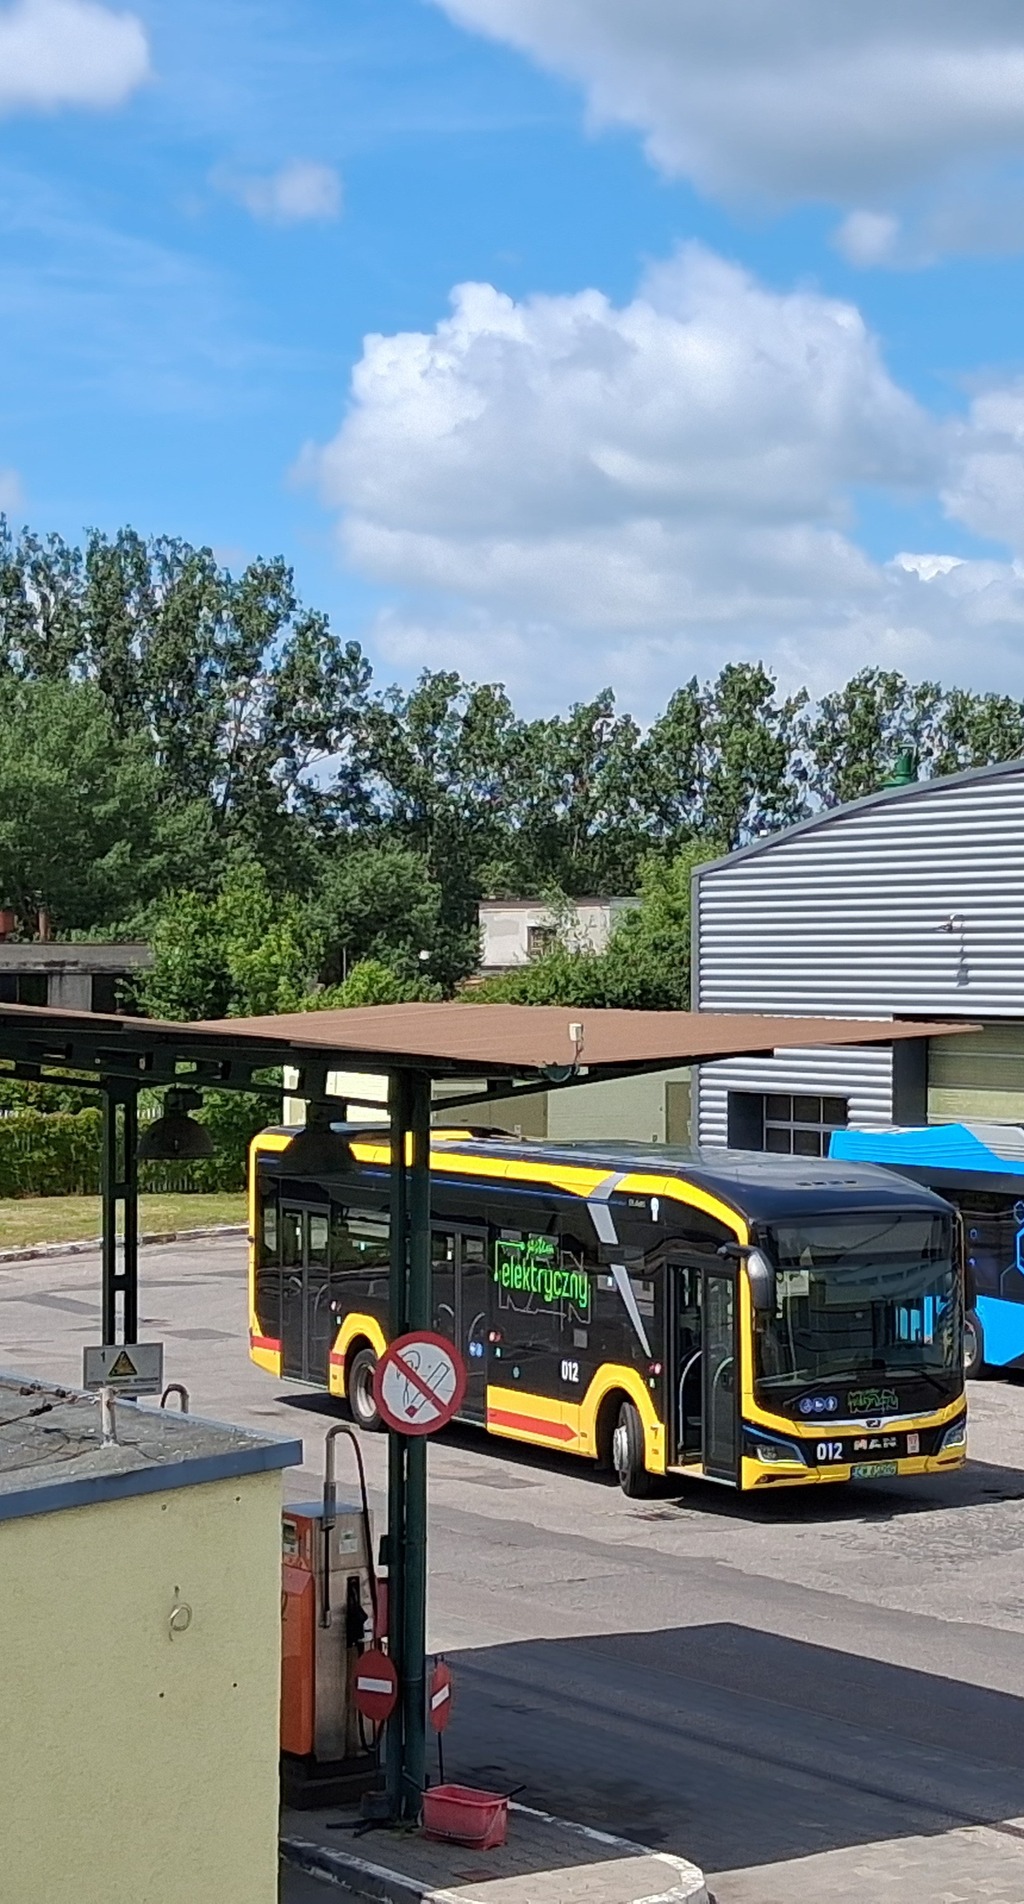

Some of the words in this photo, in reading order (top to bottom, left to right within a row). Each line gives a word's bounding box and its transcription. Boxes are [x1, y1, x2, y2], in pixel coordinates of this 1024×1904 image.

[502, 1255, 588, 1308] elektryczny
[561, 1360, 580, 1383] 012
[816, 1441, 843, 1461] 012
[853, 1437, 897, 1451] MAN
